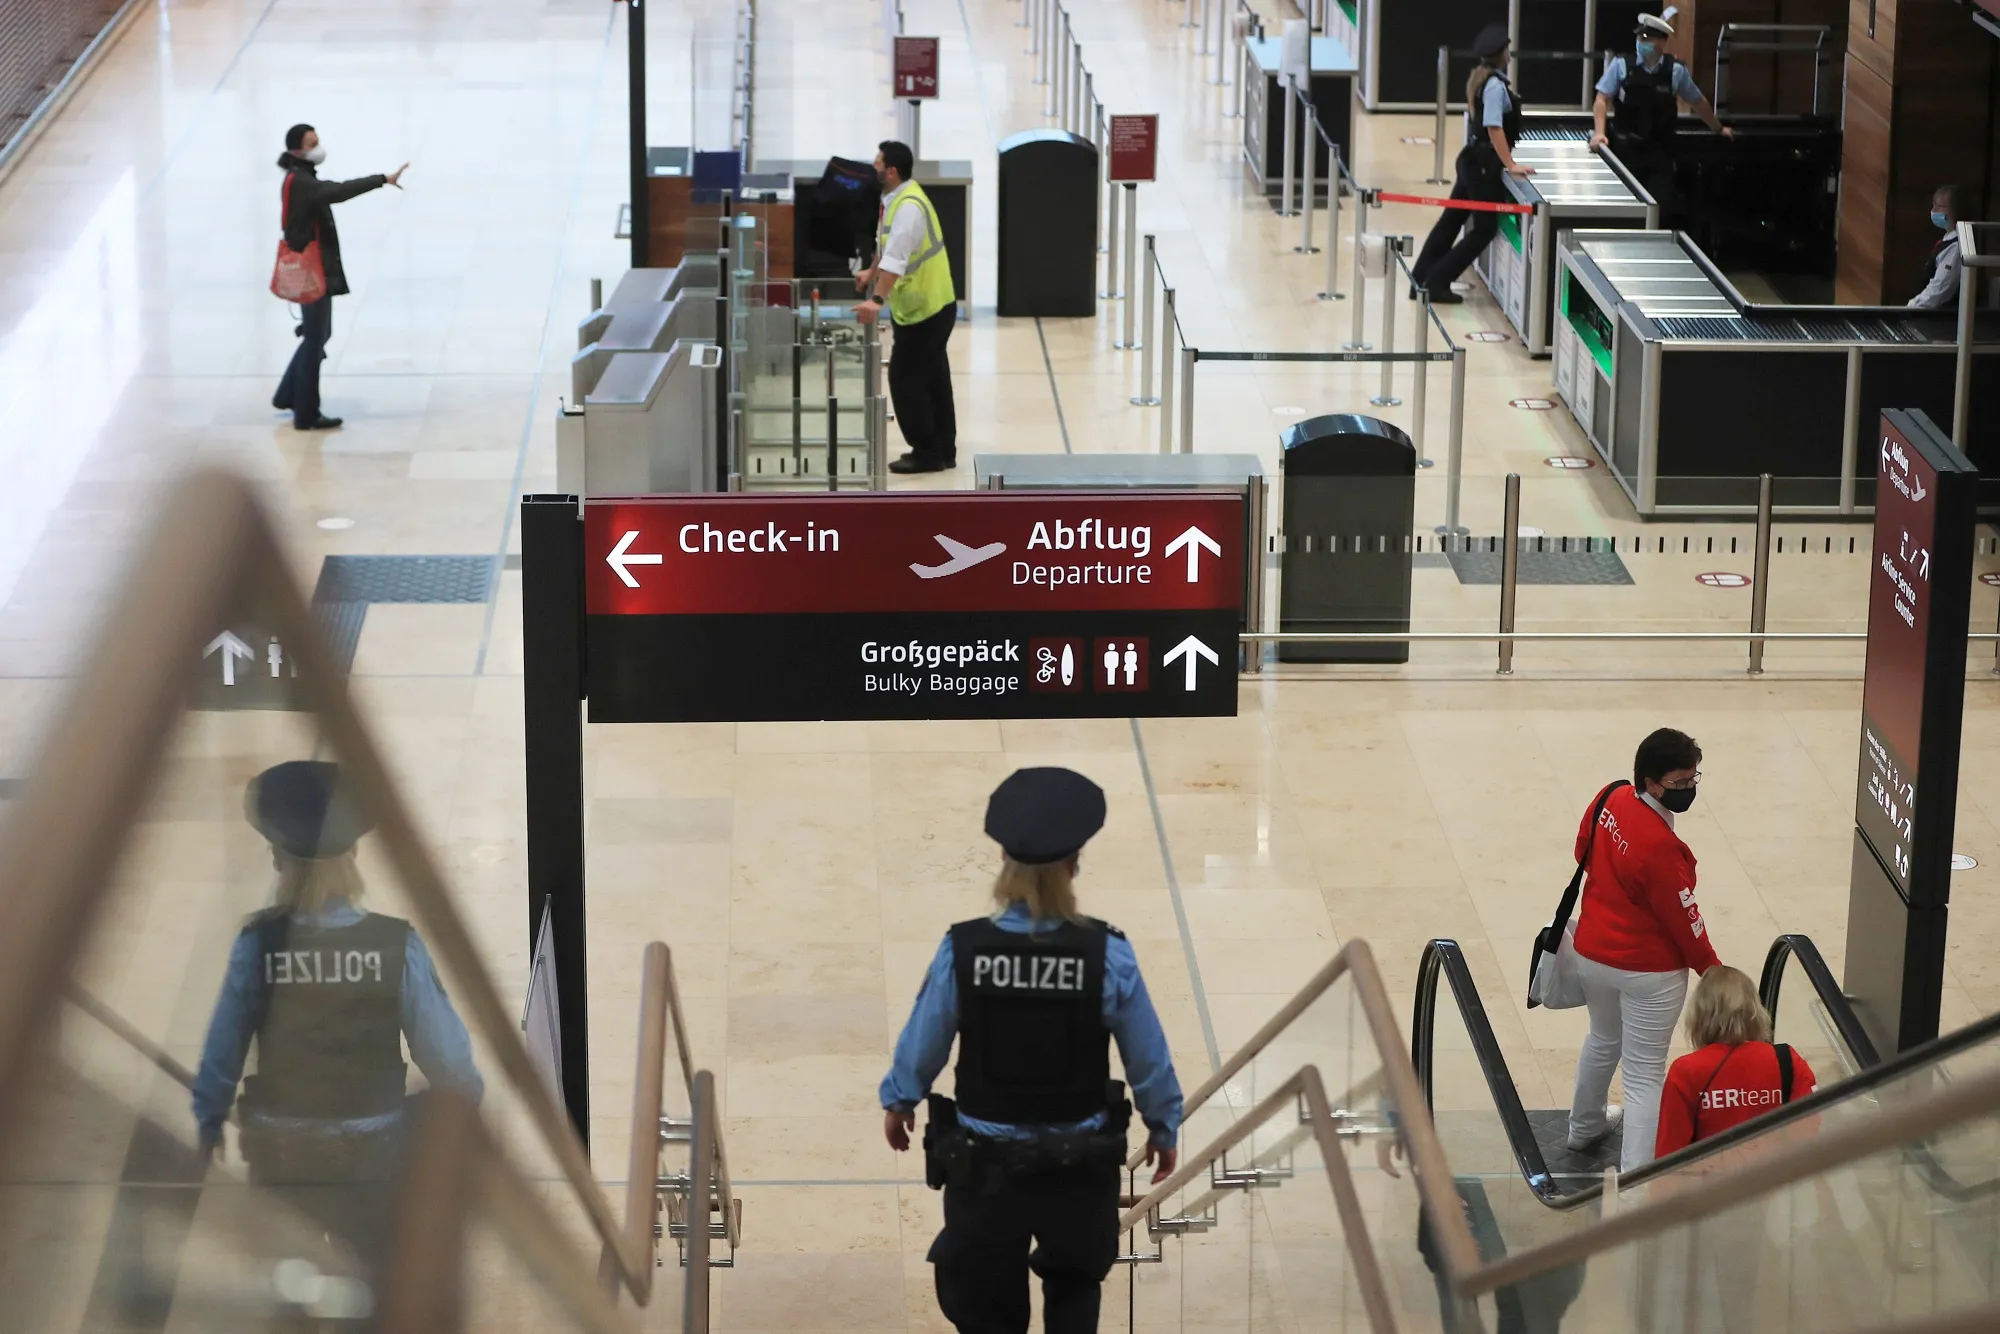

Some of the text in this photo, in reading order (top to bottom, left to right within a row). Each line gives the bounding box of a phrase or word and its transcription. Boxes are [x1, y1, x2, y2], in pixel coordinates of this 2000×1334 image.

[1890, 441, 1909, 477] Abflug
[1889, 466, 1910, 499] Departure
[679, 521, 839, 553] Check-in
[1026, 518, 1151, 558] Abflug
[1012, 561, 1152, 591] Departure
[1881, 552, 1916, 606] Airline Service
[1894, 592, 1915, 628] Counter
[861, 639, 1020, 669] Großgepäck
[865, 672, 1019, 696] Bulky Baggage
[973, 954, 1084, 990] POLIZEI
